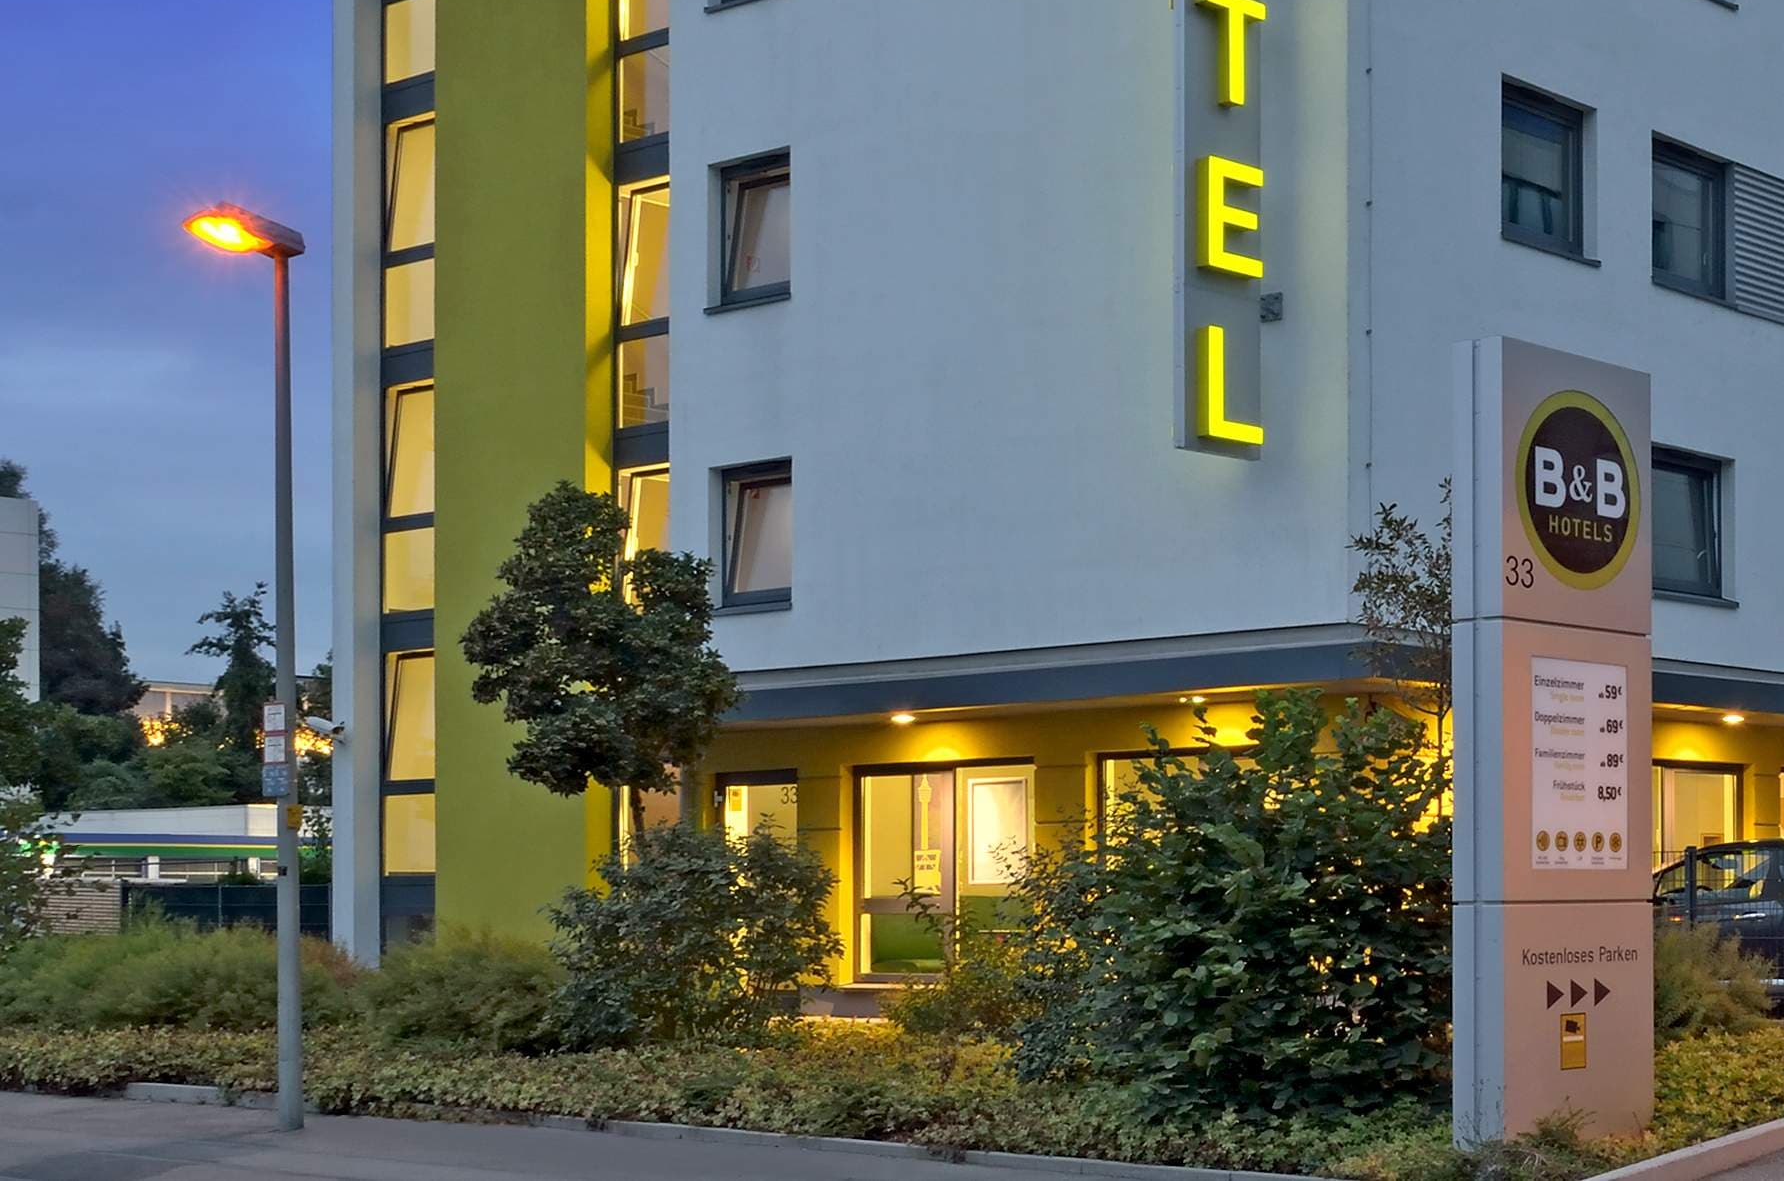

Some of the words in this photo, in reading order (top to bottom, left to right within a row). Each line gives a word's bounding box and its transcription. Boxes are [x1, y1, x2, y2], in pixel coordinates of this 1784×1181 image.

[1534, 445, 1627, 519] B&B
[1549, 515, 1613, 543] HOTELS
[1505, 555, 1535, 588] 33
[780, 785, 799, 804] 33
[1522, 947, 1594, 966] Kostenloses
[1599, 945, 1638, 962] Parken
